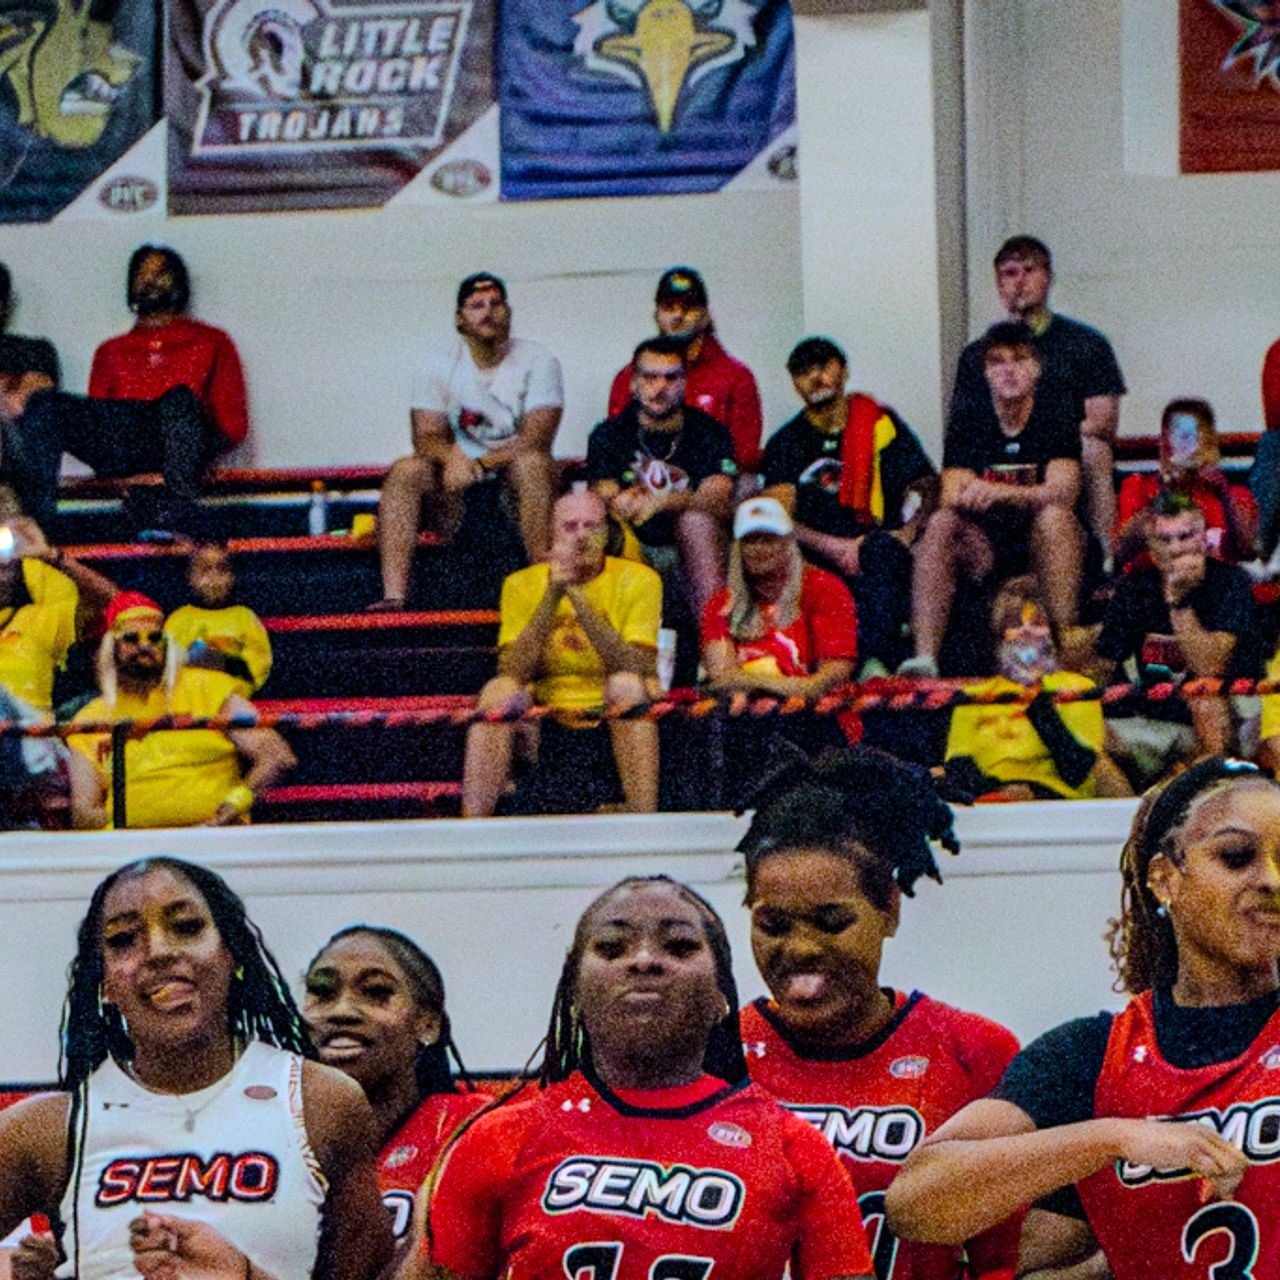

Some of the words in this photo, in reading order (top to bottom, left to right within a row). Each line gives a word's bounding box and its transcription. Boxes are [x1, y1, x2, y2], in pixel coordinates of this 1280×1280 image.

[318, 16, 456, 57] LITTLE
[308, 54, 444, 97] ROCK
[236, 106, 405, 143] TROJANS
[94, 1151, 281, 1207] SEMO
[542, 1155, 745, 1231] SEMO
